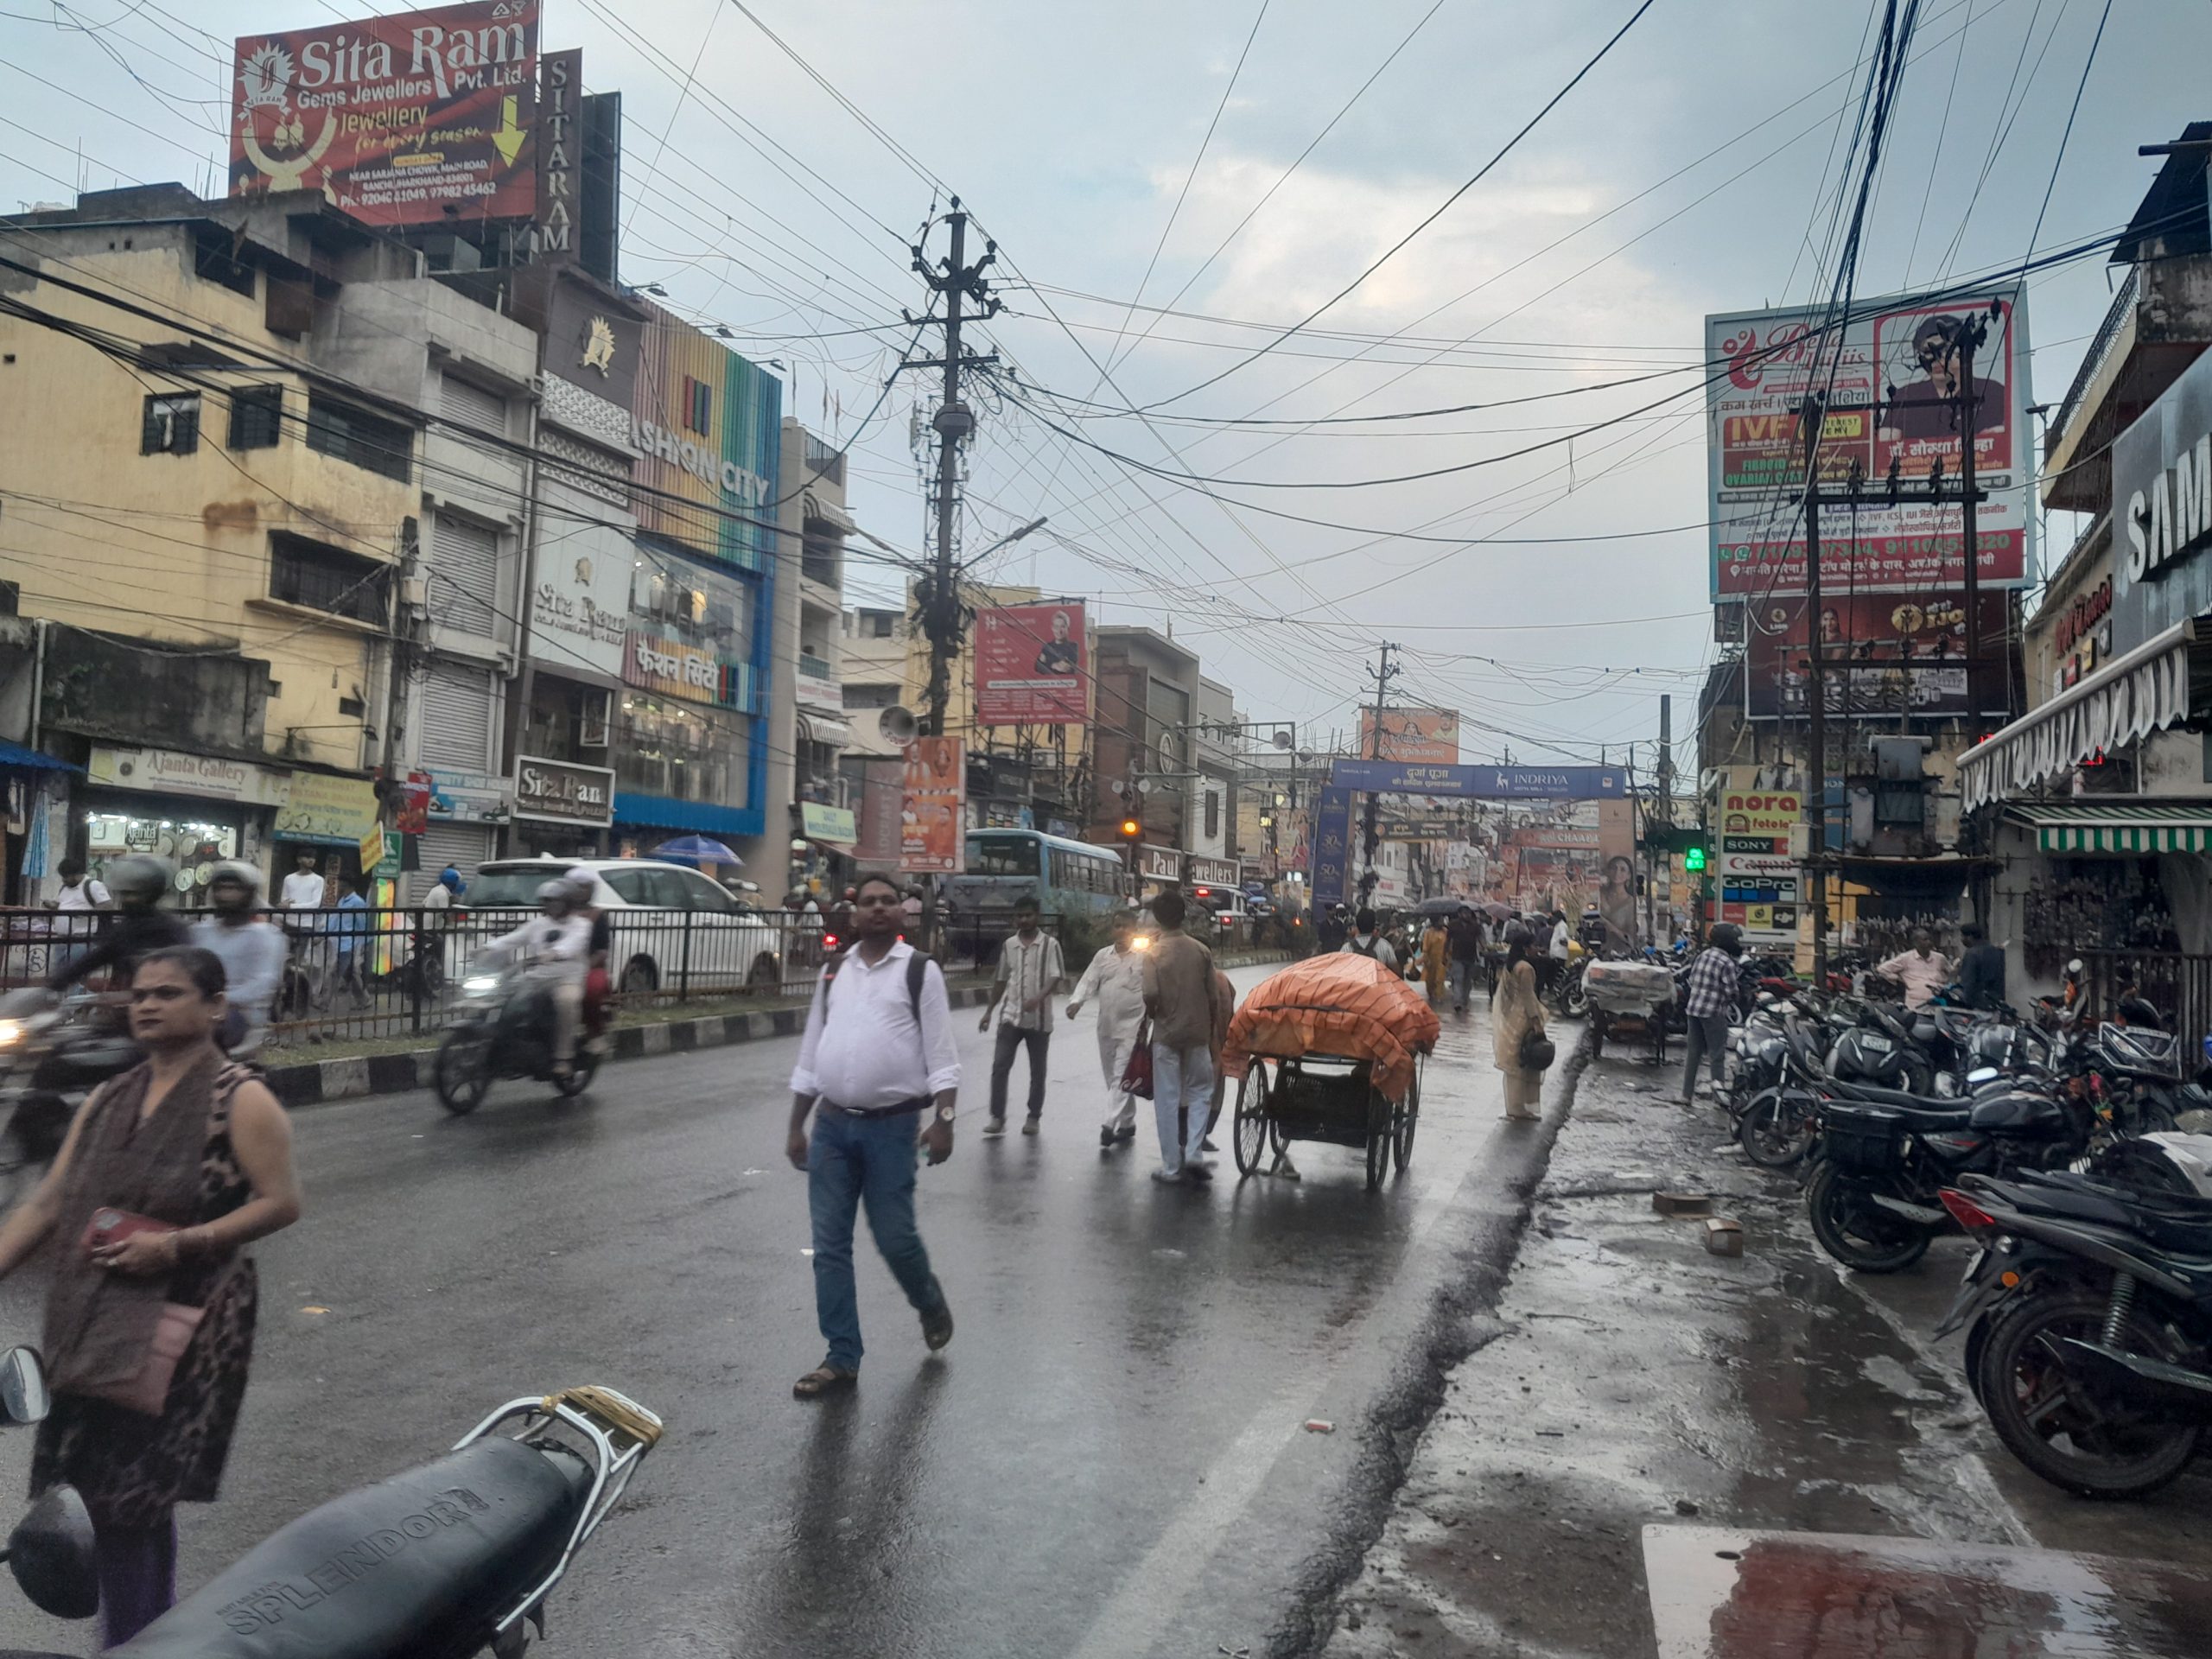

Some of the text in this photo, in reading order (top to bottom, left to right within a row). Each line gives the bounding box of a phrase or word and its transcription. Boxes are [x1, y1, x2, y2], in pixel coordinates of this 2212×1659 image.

[298, 22, 526, 99] Sita Ram
[296, 65, 526, 109] Gems Jewellers Pvt. Ltd.
[340, 105, 429, 137] Jewellery
[1732, 415, 1789, 441] IVF
[630, 414, 770, 506] ASHION CITY
[636, 639, 720, 690] फैशन सिटी
[147, 750, 195, 774] Ajanta
[198, 758, 248, 785] Gallery
[1429, 768, 1449, 779] पूजा
[1514, 773, 1569, 785] INDRIYA
[1727, 795, 1797, 811] nora
[1728, 841, 1770, 849] SONY
[1152, 851, 1179, 876] Paul
[1723, 877, 1796, 890] GoPro
